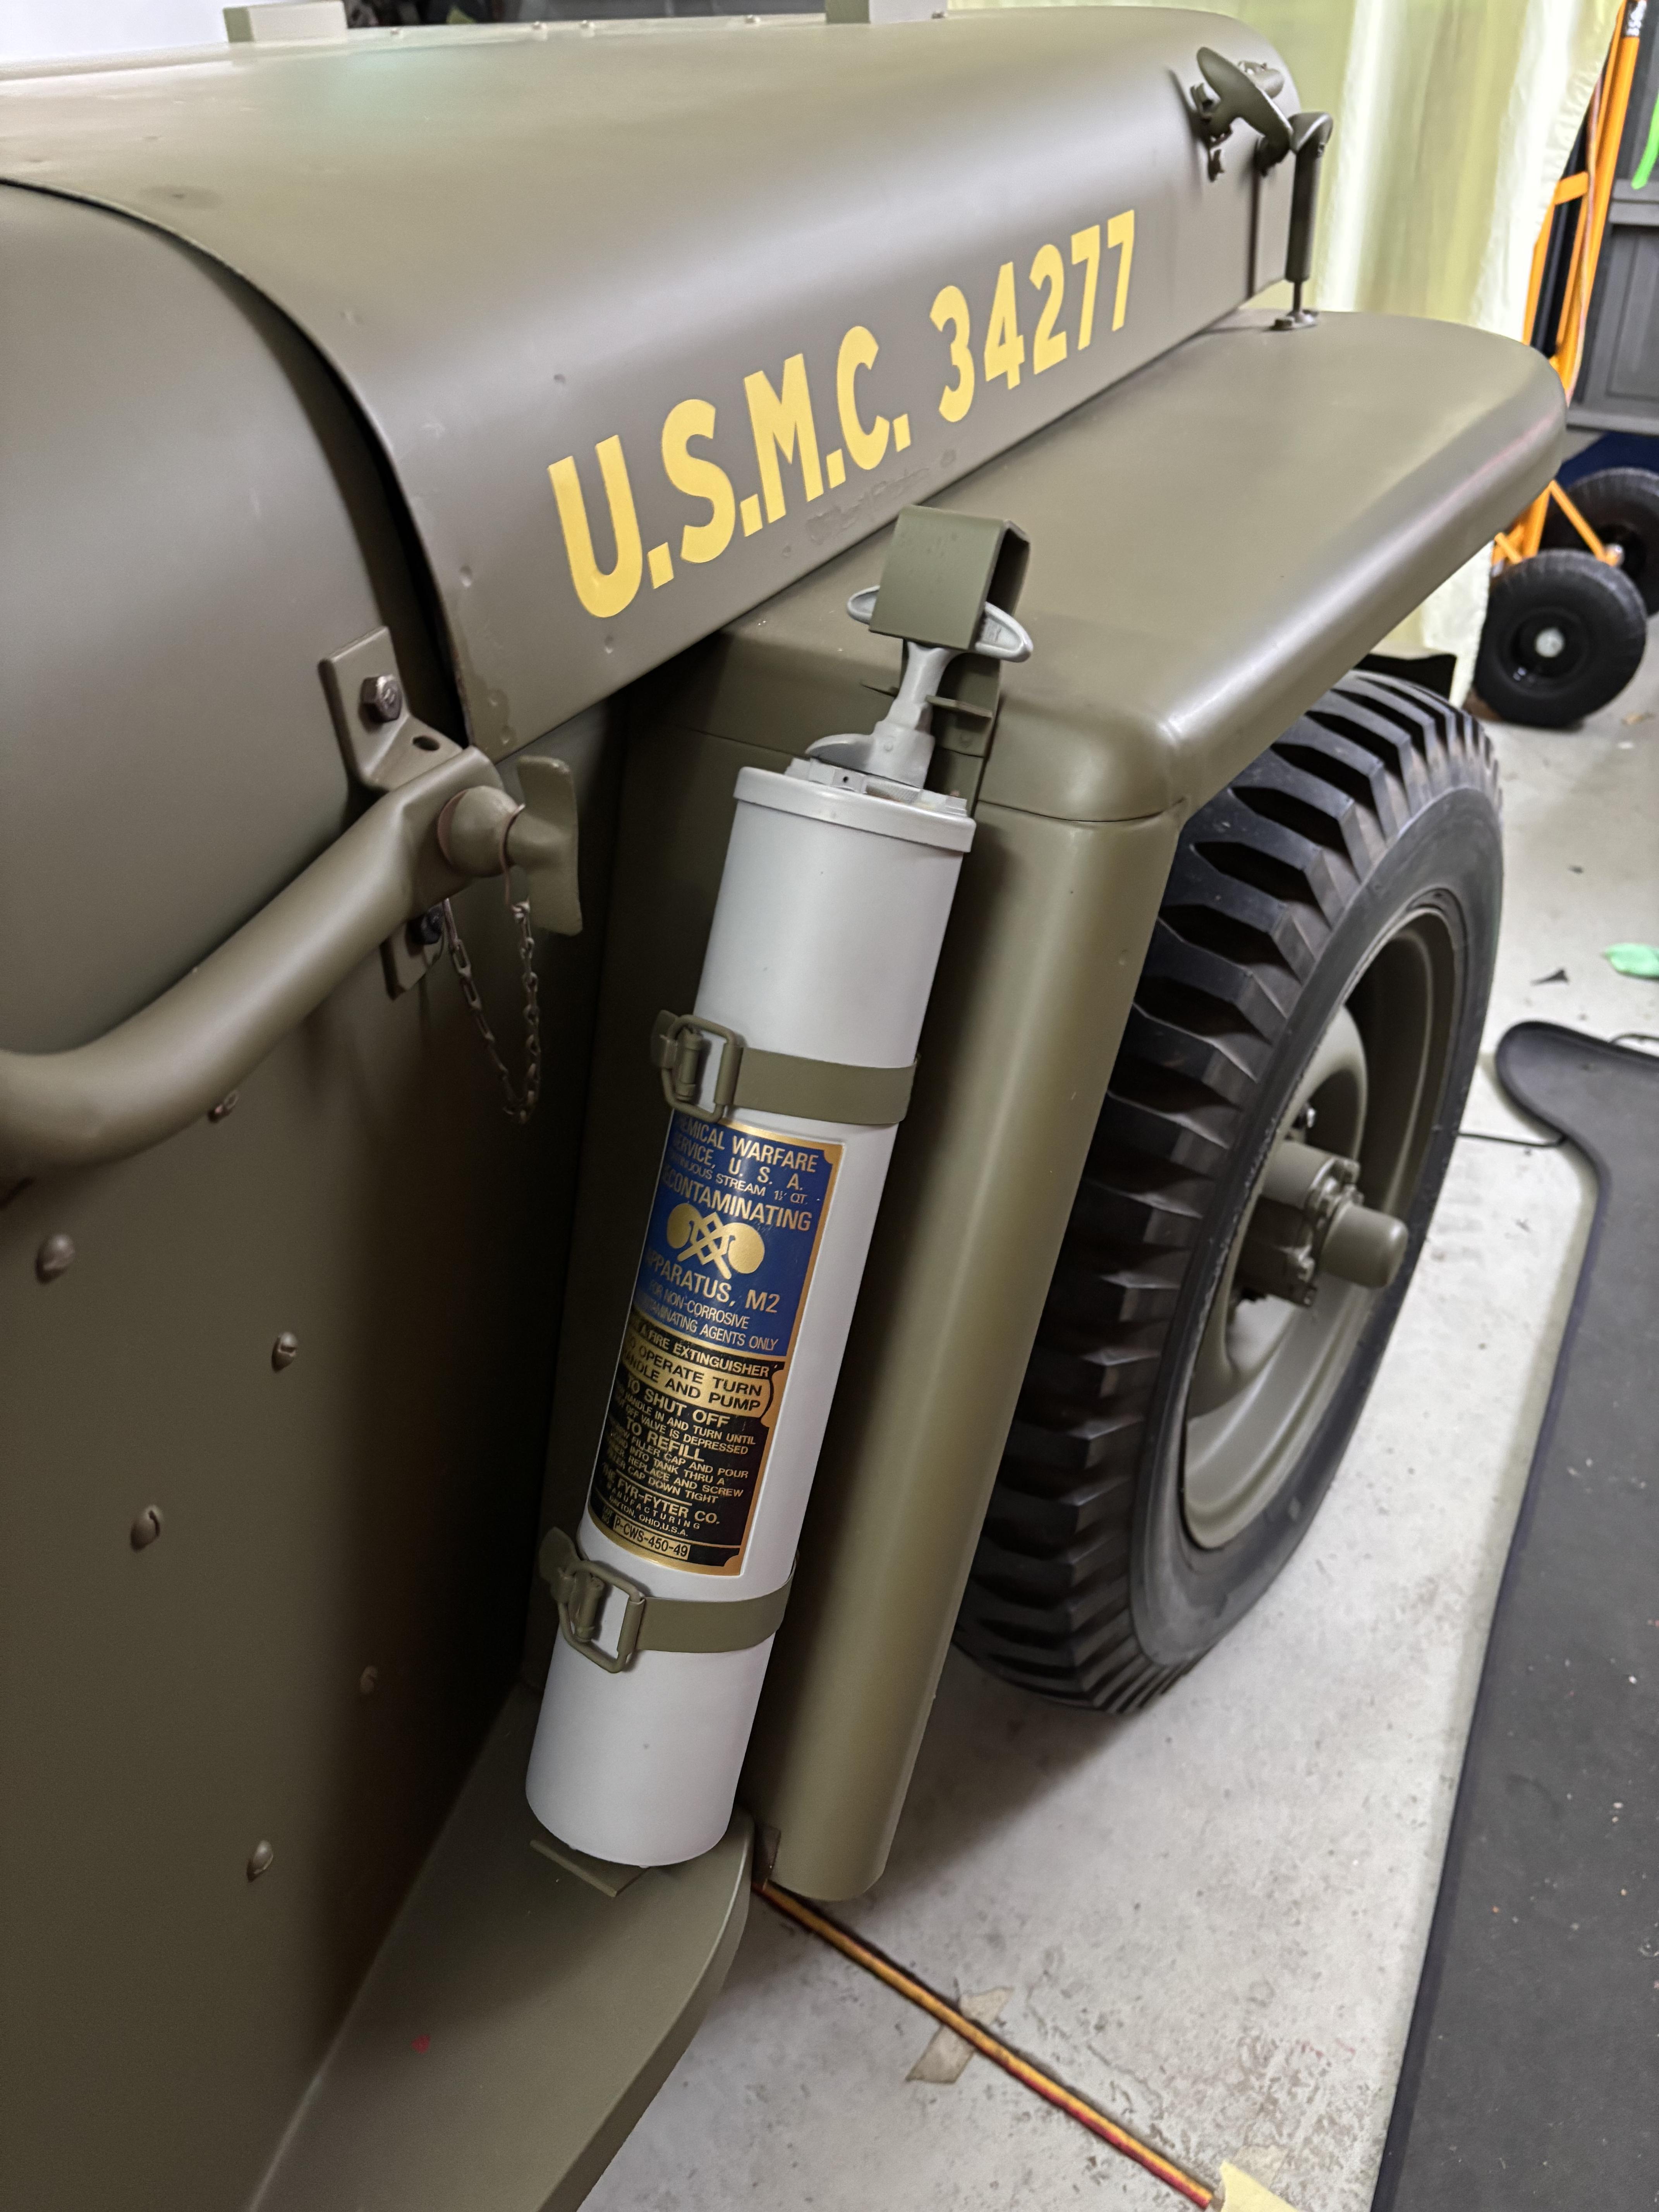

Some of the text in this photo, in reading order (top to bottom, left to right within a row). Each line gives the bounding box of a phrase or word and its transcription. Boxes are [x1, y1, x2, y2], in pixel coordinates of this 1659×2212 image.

[547, 208, 1135, 618] U.S.M.C. 34277
[728, 1157, 742, 1176] U.
[757, 1166, 772, 1185] S.
[787, 1173, 803, 1191] A.
[732, 1135, 818, 1173] WARFARE
[661, 1164, 812, 1231] CONTAMINATING
[716, 1173, 766, 1197] STREAM
[664, 1289, 750, 1329] NON-CORROSIVE
[745, 1290, 780, 1313] M2
[647, 1329, 670, 1350] FIRE
[673, 1343, 769, 1377] EXTINGUISHER
[699, 1324, 746, 1346] AGENTS
[749, 1336, 779, 1351] ONLY
[639, 1345, 704, 1384] OPERATE
[713, 1376, 762, 1396] TURN
[628, 1377, 640, 1393] TO
[644, 1388, 687, 1417] SHUT
[692, 1409, 730, 1429] OFF
[665, 1377, 701, 1399] AND
[708, 1392, 760, 1411] PUMP
[625, 1393, 756, 1445] HANDLE IN AND TURN UNTIL
[641, 1415, 666, 1434] VALVE
[669, 1429, 680, 1439] IS
[683, 1434, 748, 1455] DEPRESSED
[626, 1417, 642, 1436] TO
[647, 1431, 704, 1462] REFILL
[631, 1436, 660, 1458] FILLER
[664, 1452, 686, 1465] CAP
[689, 1463, 713, 1474] AND
[717, 1468, 749, 1479] POUR
[628, 1456, 744, 1498] REPLACE AND SCREW
[630, 1445, 649, 1461] INTO
[653, 1459, 678, 1475] TANK
[684, 1469, 713, 1483] THRU
[618, 1479, 688, 1518] FYR-FYTER
[694, 1511, 720, 1525] CO.
[627, 1466, 646, 1480] CAP
[648, 1477, 681, 1496] DOWN
[685, 1489, 718, 1503] TIGHT
[615, 1517, 689, 1557] P-CWS-450-49
